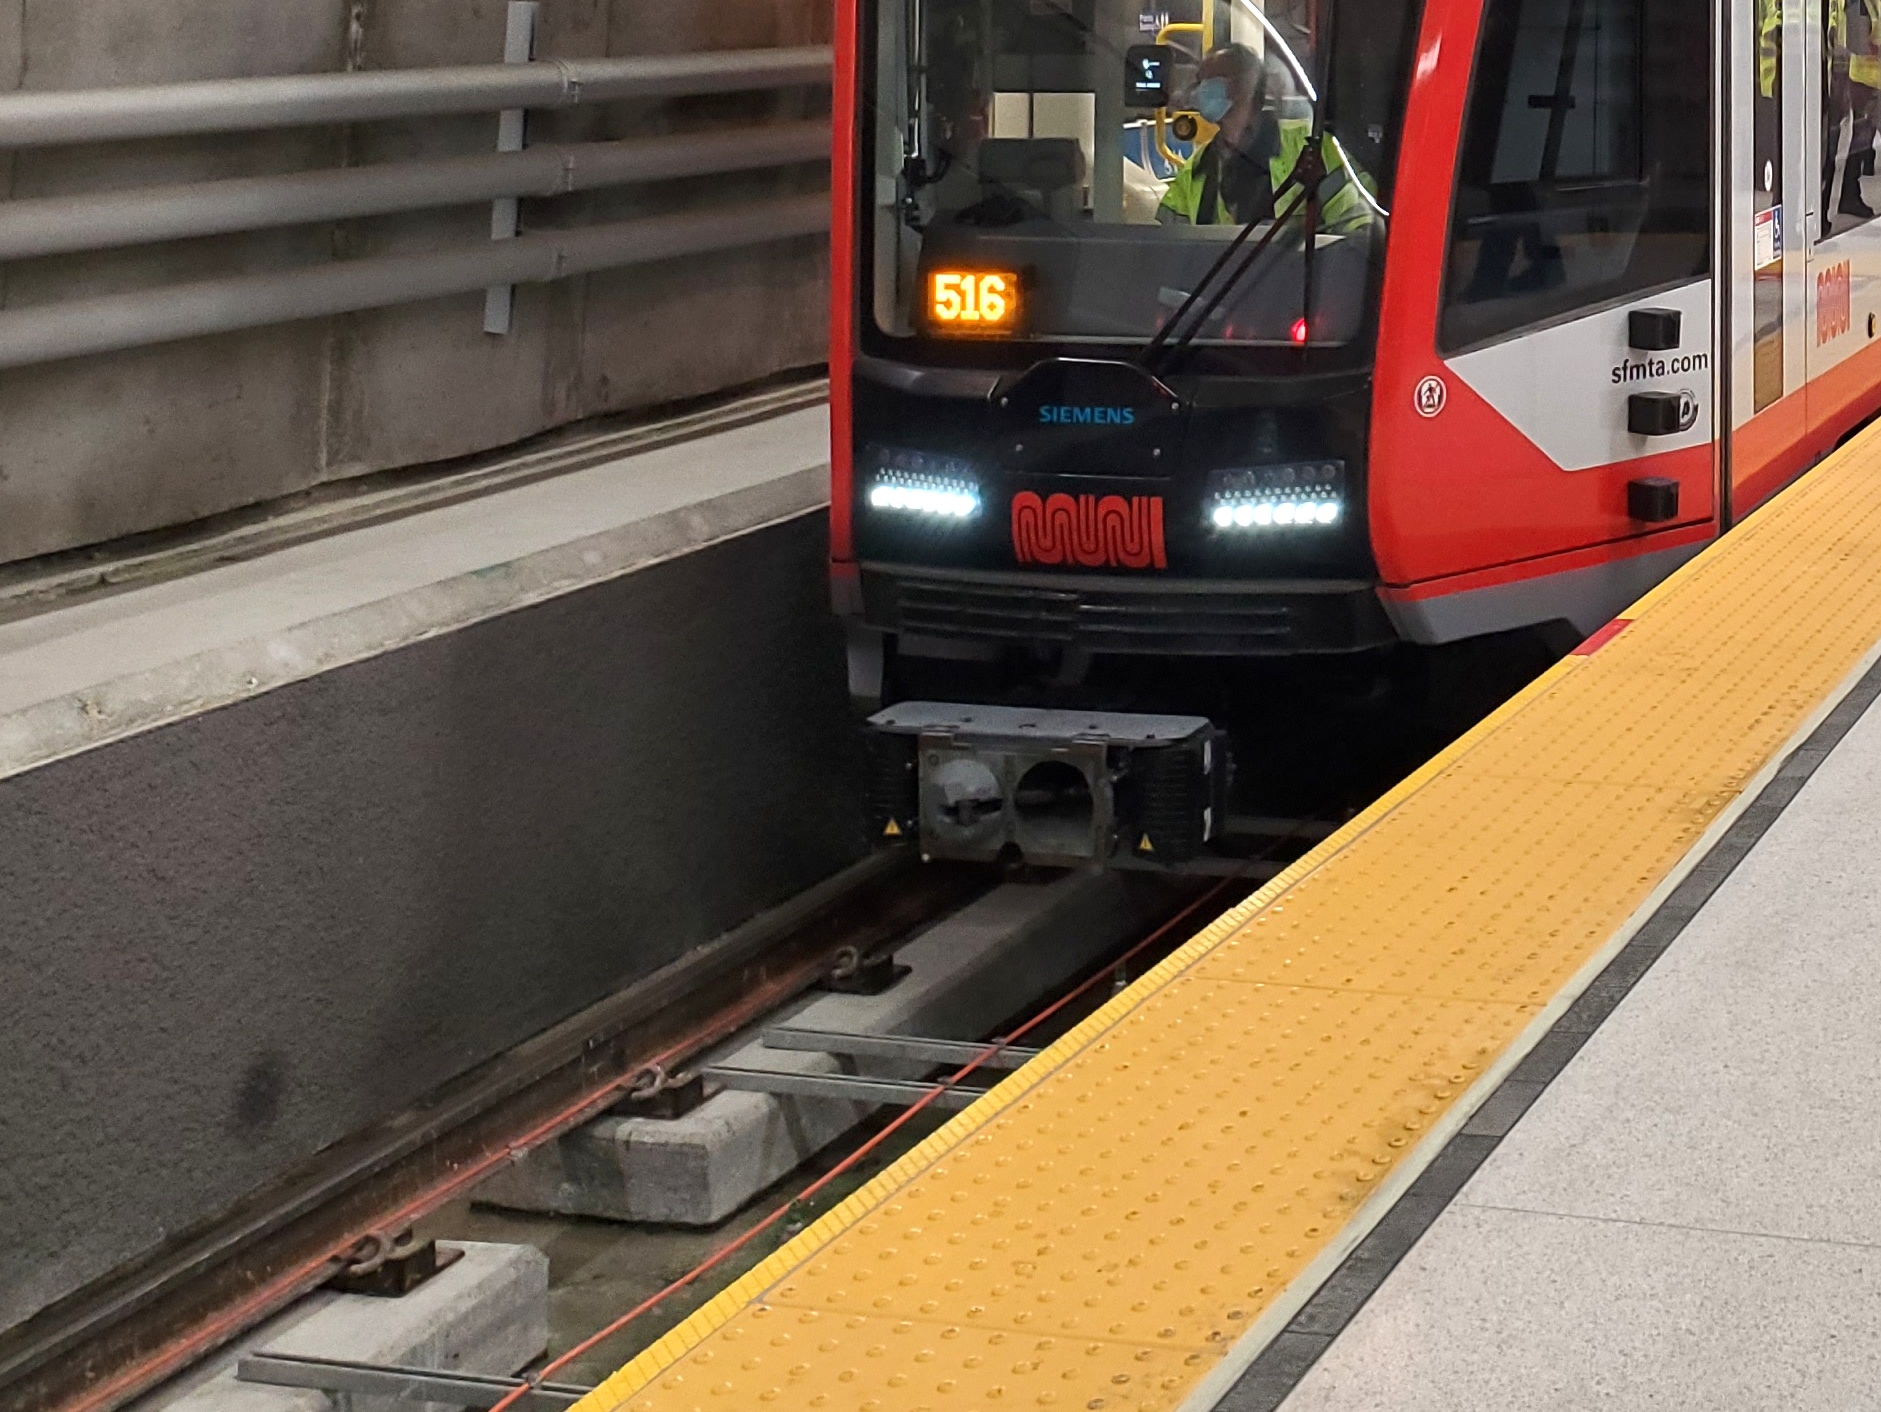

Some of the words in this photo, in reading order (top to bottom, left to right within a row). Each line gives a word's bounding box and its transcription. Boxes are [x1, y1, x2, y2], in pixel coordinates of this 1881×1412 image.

[935, 273, 1006, 321] 516
[1611, 353, 1708, 384] sfmta.com
[1039, 405, 1136, 425] SIEMENS
